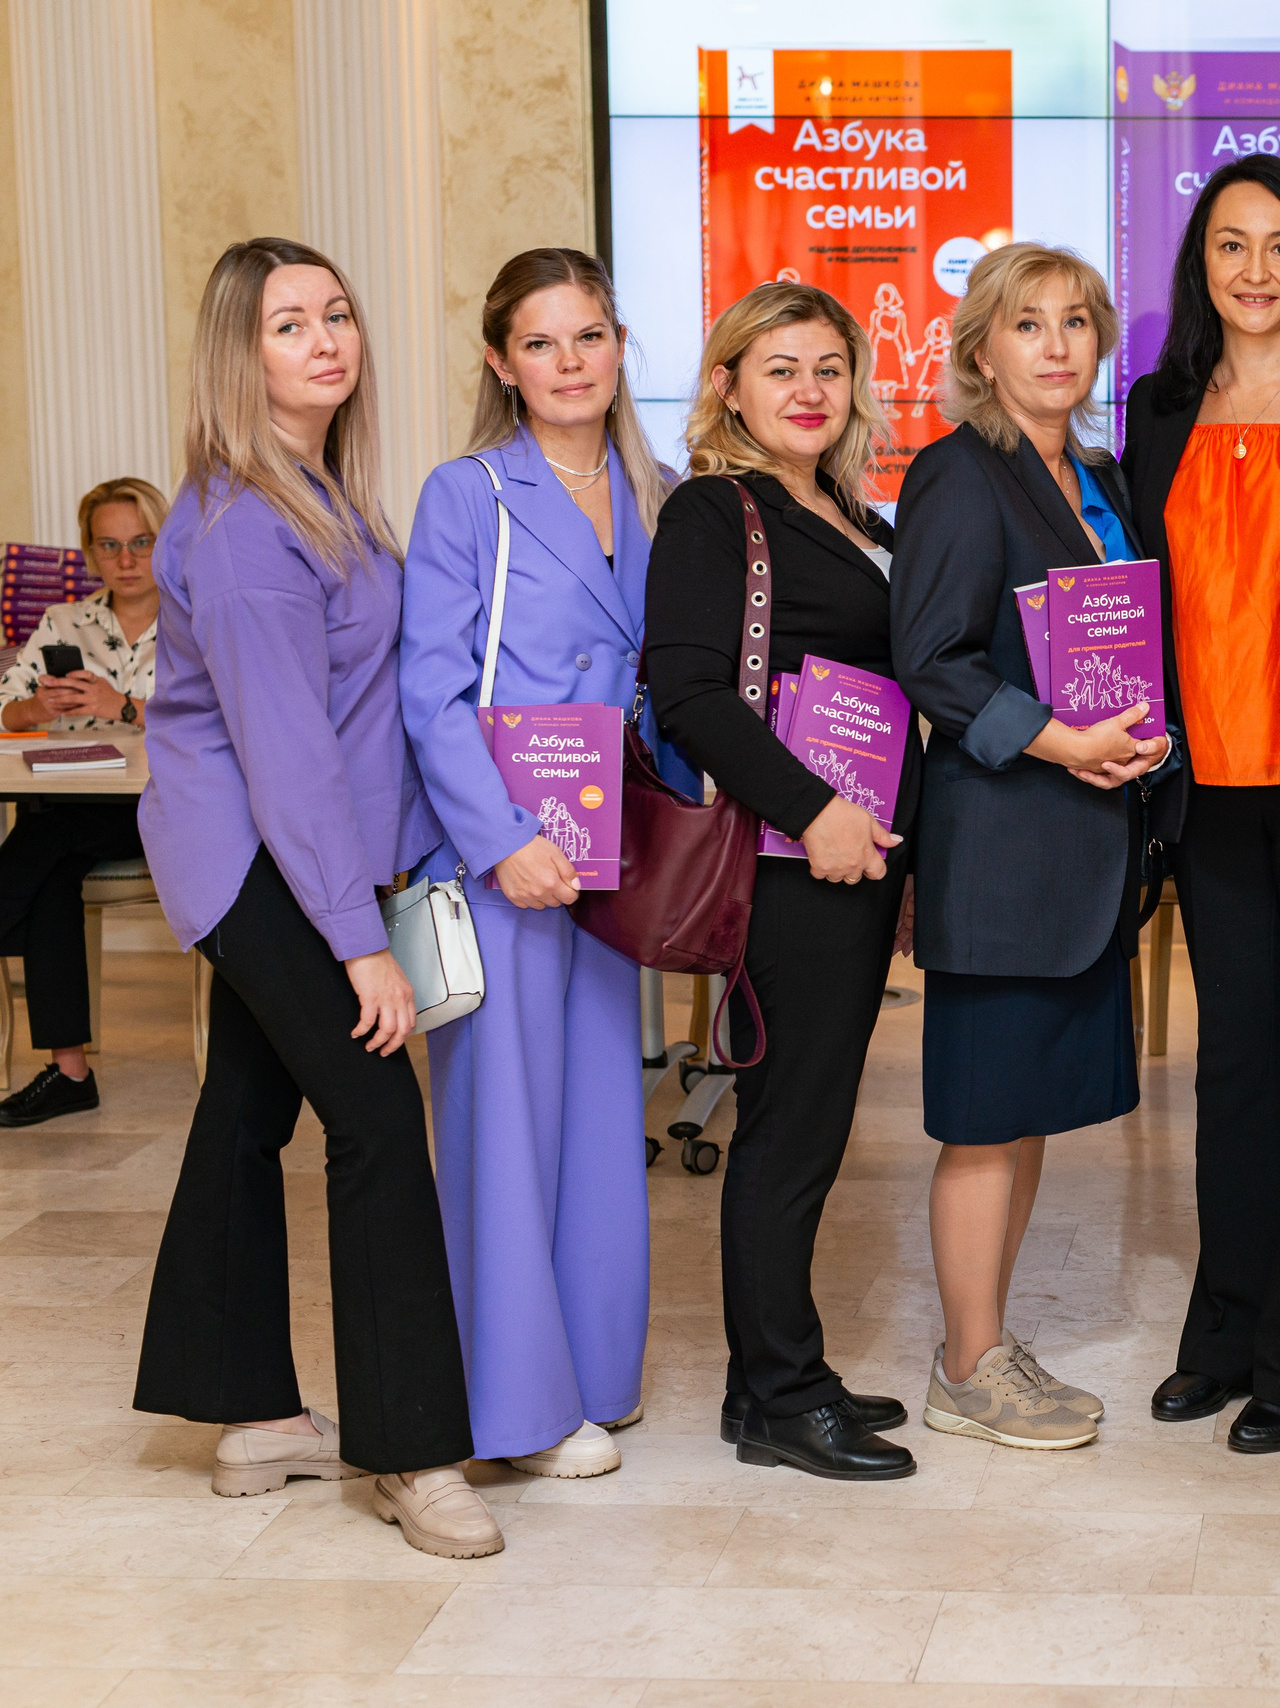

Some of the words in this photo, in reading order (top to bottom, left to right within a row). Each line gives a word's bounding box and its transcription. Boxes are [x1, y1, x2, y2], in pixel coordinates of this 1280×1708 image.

[793, 119, 928, 161] Азбука
[754, 160, 967, 191] счастливой
[805, 204, 917, 229] семьи
[1082, 593, 1131, 609] Азбука
[1067, 606, 1145, 624] счастливой
[1087, 625, 1128, 638] семьи
[1114, 639, 1146, 650] родителей
[830, 690, 881, 716] Азбука
[812, 704, 892, 735] счастливой
[528, 734, 585, 750] Азбука
[829, 724, 872, 744] семьи
[511, 751, 601, 763] счастливой
[532, 767, 580, 778] семьи
